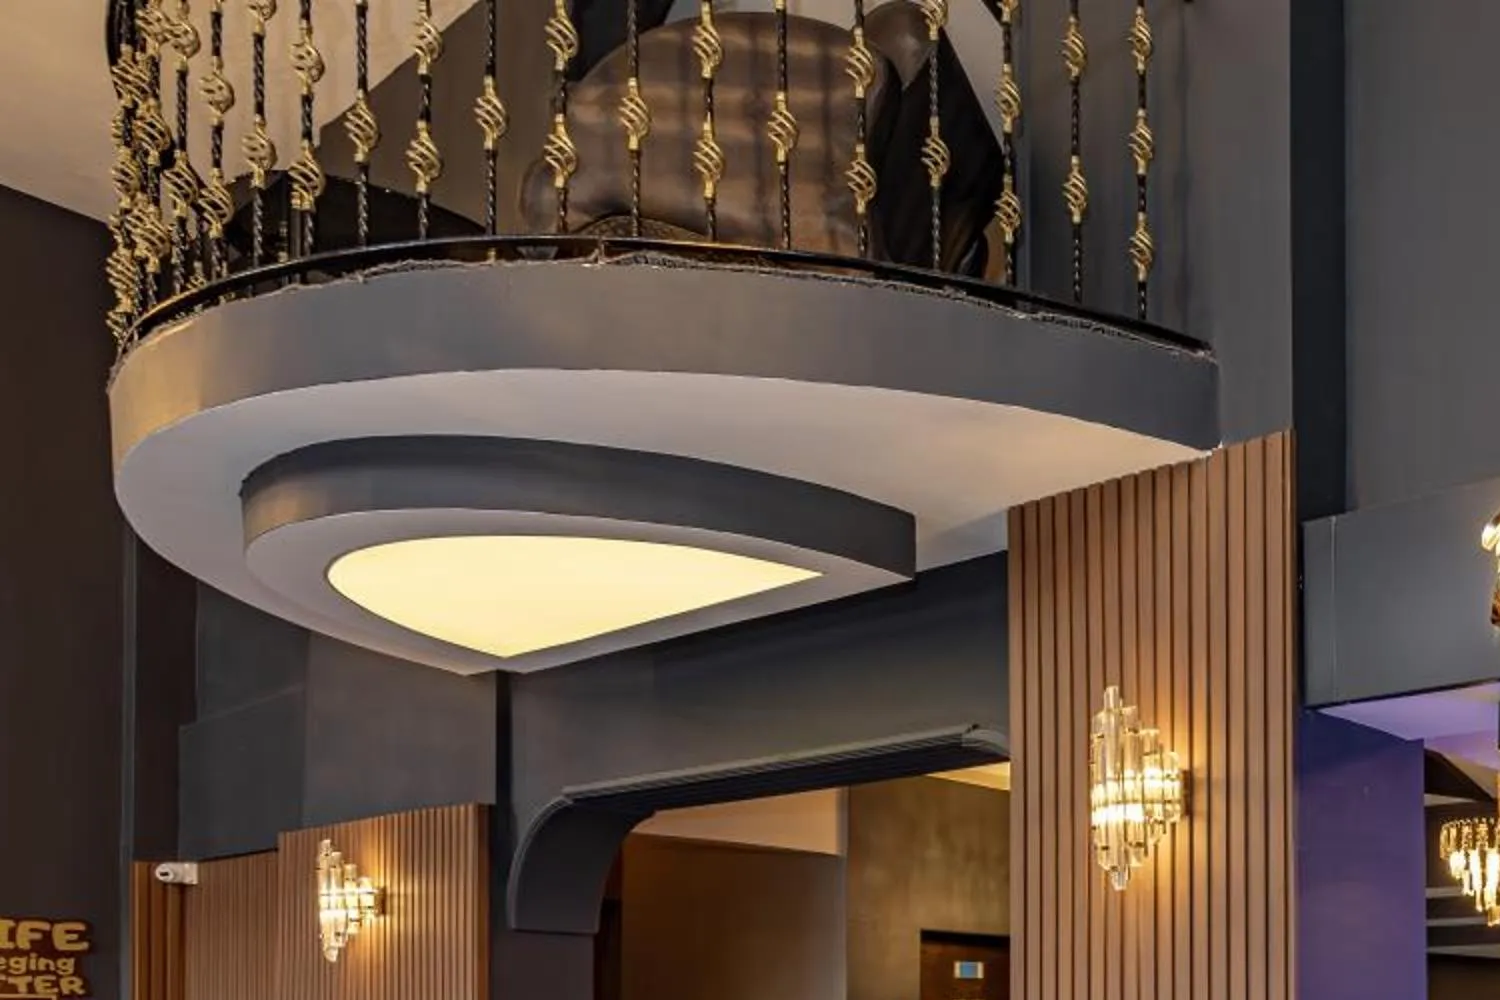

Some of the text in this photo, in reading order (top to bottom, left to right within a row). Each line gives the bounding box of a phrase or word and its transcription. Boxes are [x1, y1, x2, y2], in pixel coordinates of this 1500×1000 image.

[0, 919, 90, 951] IFE
[0, 952, 76, 976] eging
[0, 974, 87, 996] TER
